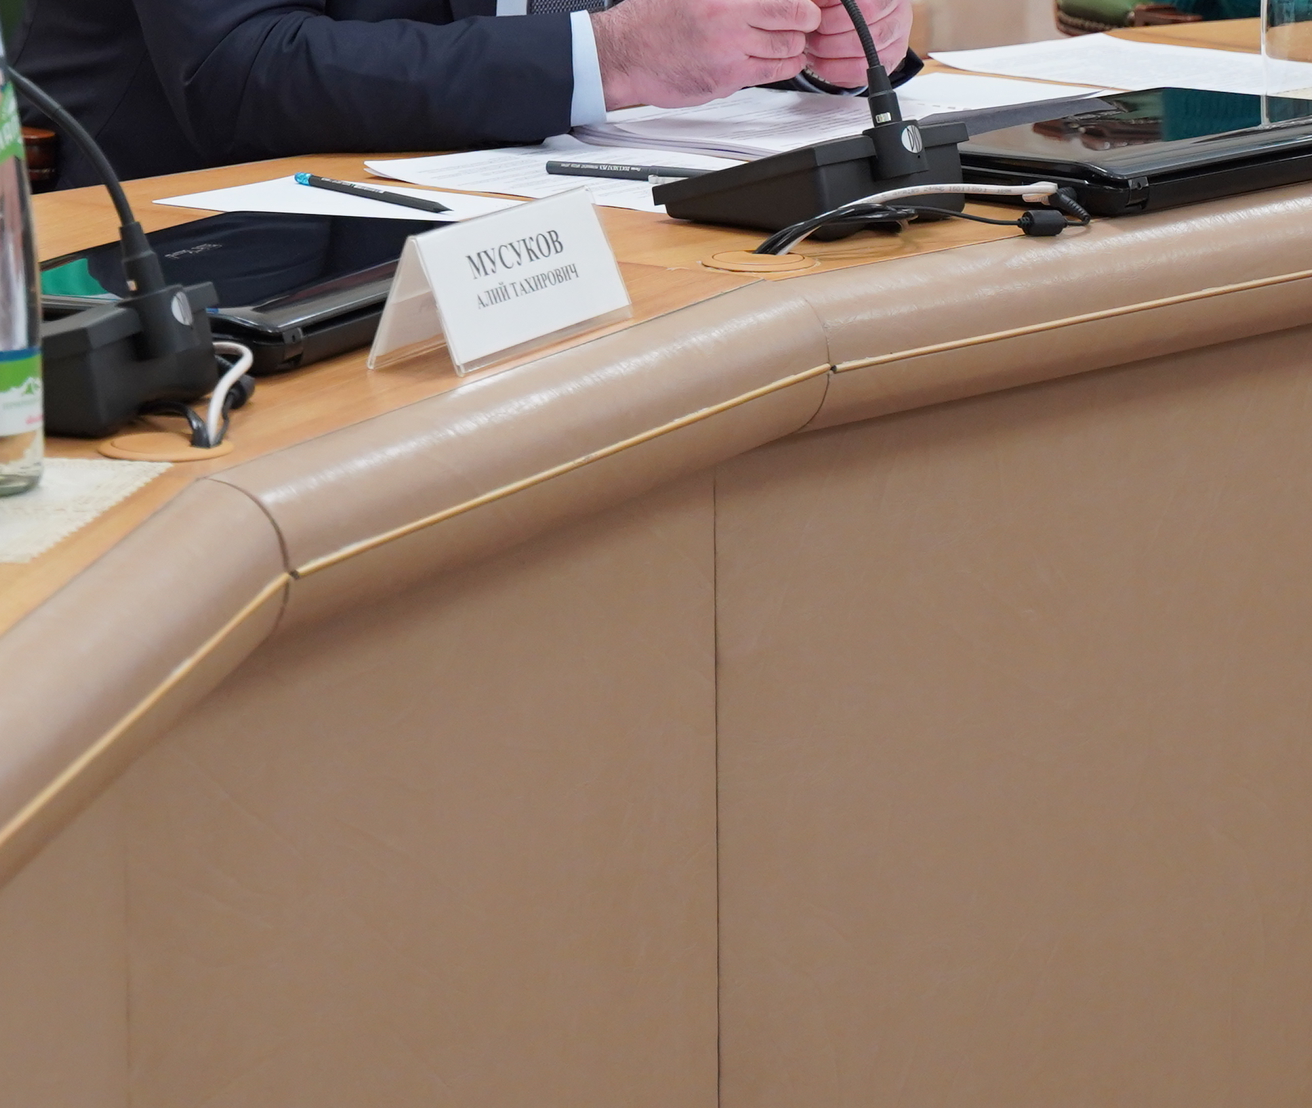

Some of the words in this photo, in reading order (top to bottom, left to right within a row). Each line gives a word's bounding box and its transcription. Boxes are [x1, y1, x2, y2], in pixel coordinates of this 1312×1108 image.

[465, 229, 564, 280] МУСУКОВ
[476, 283, 510, 310] АЛИЙ
[511, 263, 579, 298] ТАХИРОВИЧ
